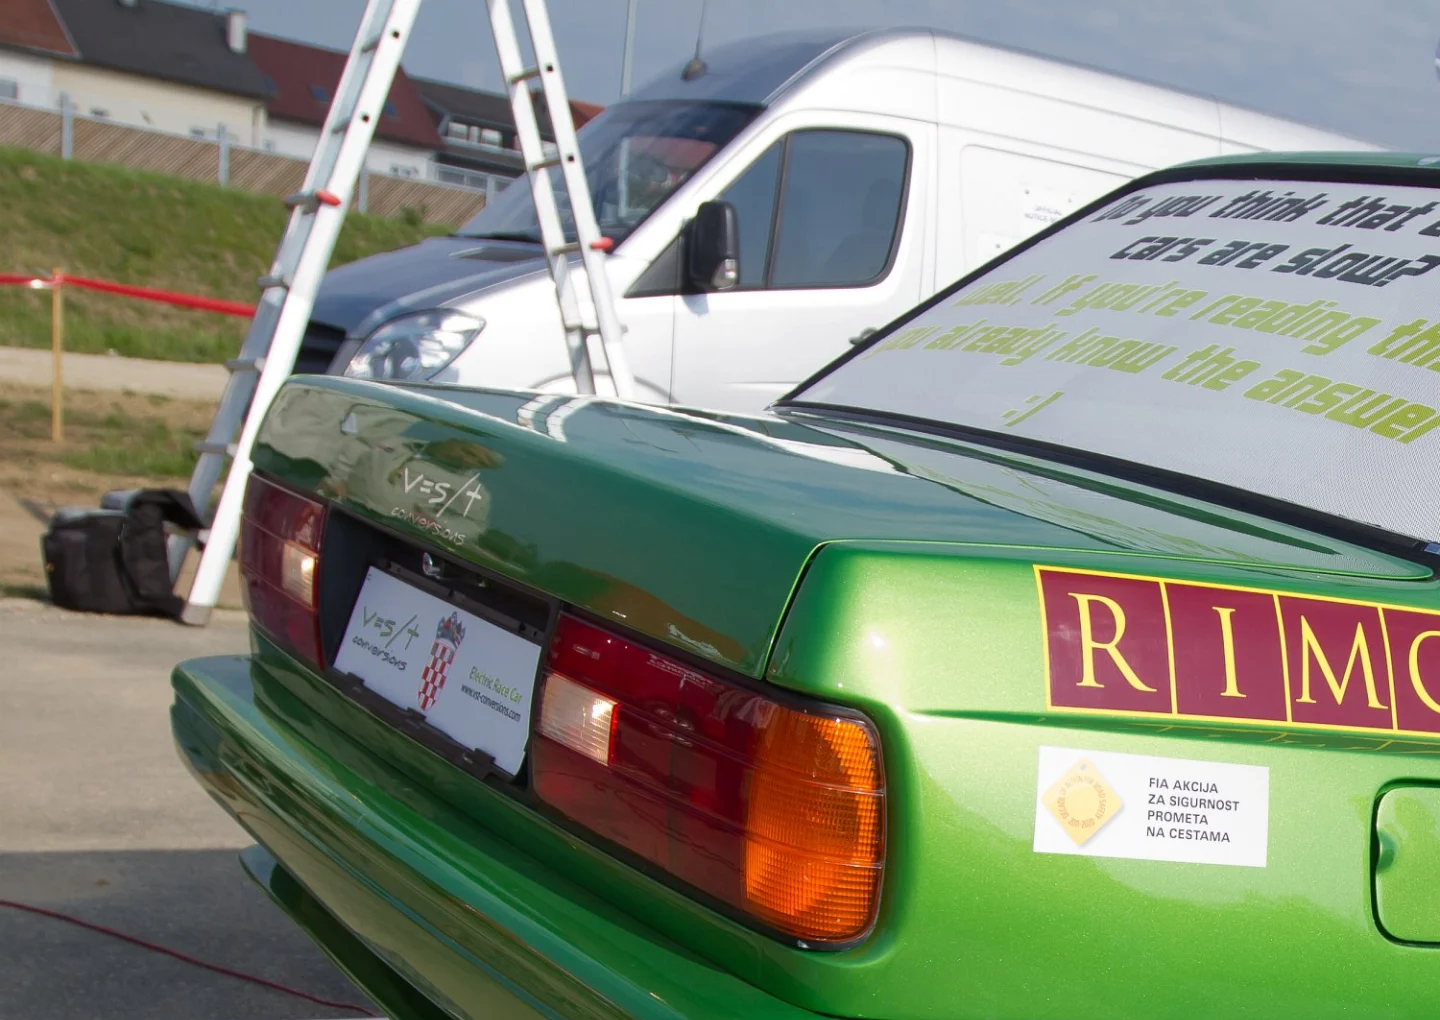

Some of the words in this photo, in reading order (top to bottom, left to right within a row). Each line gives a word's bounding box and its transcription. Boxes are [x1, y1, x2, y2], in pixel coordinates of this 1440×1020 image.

[1121, 196, 1224, 225] you
[1208, 190, 1329, 222] think
[1315, 196, 1440, 231] that
[1109, 236, 1217, 262] cars
[1197, 240, 1290, 269] are
[1054, 280, 1208, 317] you're
[1188, 295, 1382, 356] reading
[922, 319, 1069, 366] already
[1043, 326, 1179, 374] know
[1160, 344, 1261, 391] the
[509, 687, 523, 704] Car
[1149, 777, 1169, 789] FIA
[1173, 780, 1218, 793] AKCIJA
[1148, 793, 1165, 805] ZA
[1169, 796, 1240, 811] SIGURNOST
[1147, 810, 1208, 825] PROMETA
[1146, 826, 1165, 838] NA
[1169, 828, 1230, 843] CESTAMA
